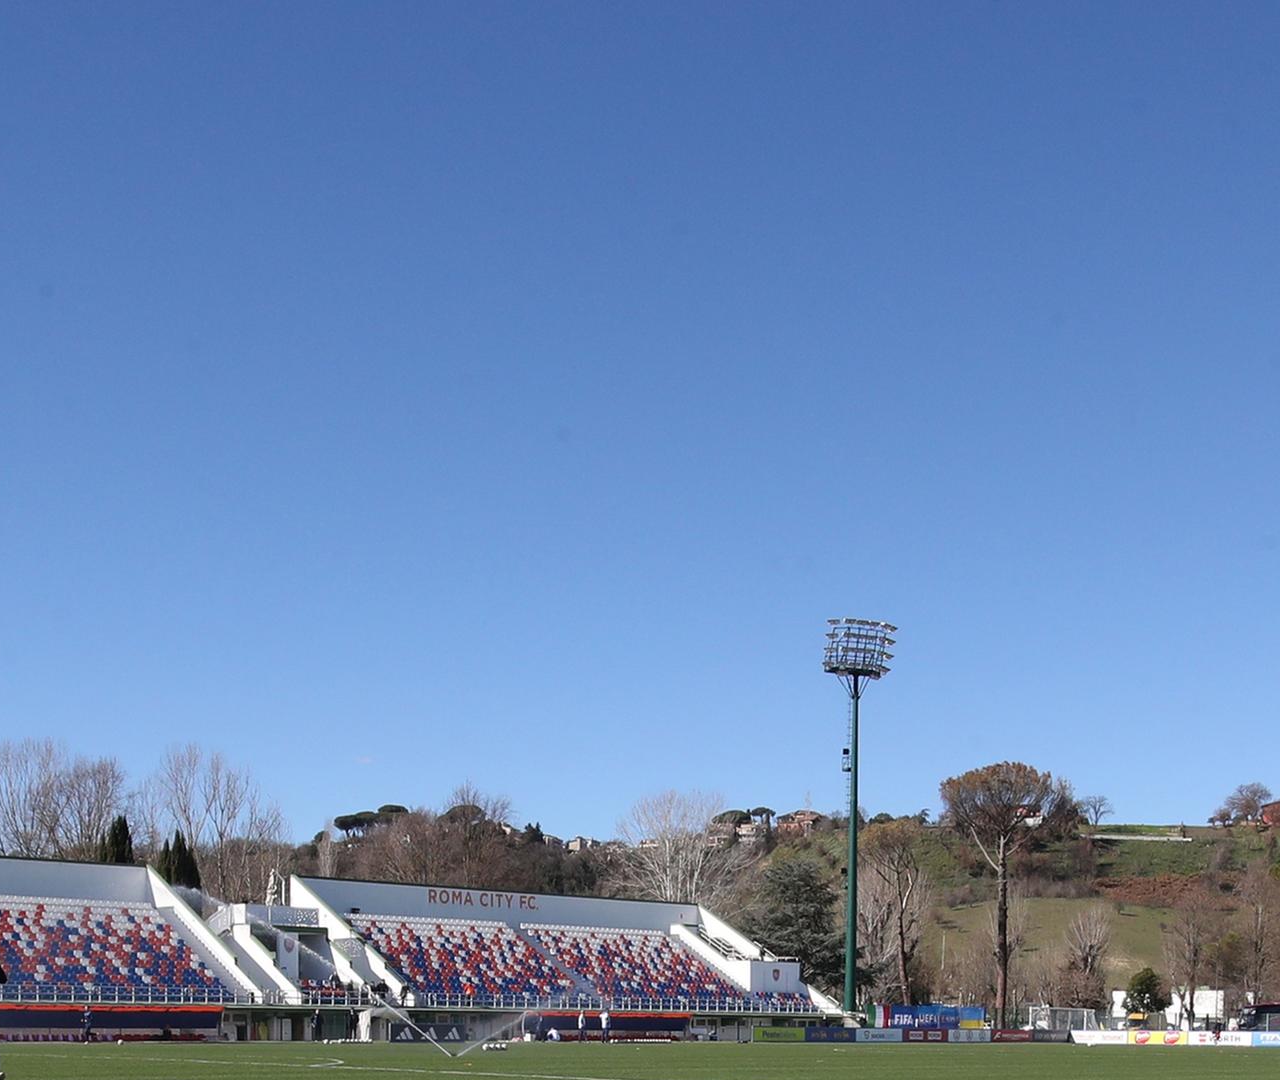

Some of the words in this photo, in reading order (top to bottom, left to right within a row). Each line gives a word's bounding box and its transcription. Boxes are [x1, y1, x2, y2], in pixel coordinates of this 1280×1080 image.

[428, 889, 474, 906] ROMA
[480, 893, 514, 908] CITY
[520, 895, 539, 910] F.C.
[894, 1014, 914, 1025] FIFA
